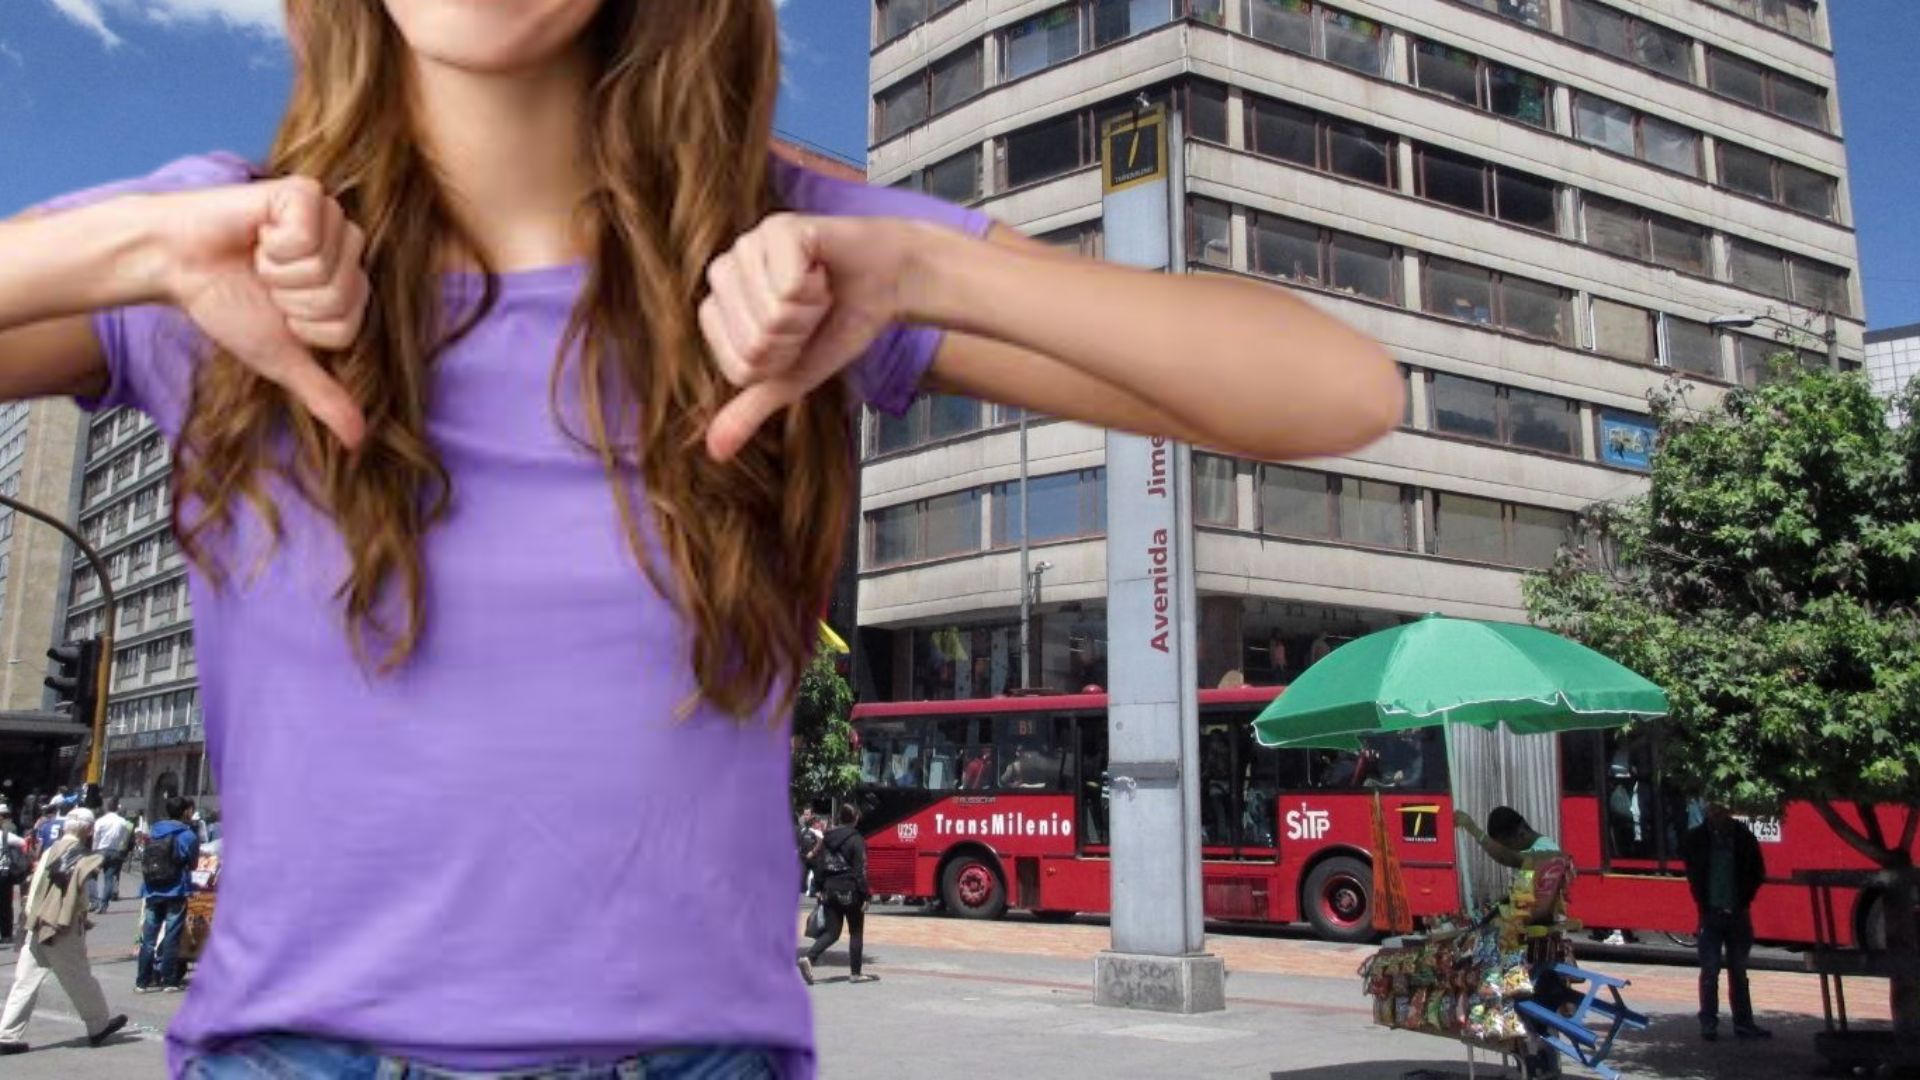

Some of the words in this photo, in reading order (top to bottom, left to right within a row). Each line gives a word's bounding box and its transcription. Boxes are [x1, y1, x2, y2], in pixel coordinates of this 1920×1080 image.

[1148, 528, 1169, 653] Avenida
[897, 823, 918, 837] U250
[935, 813, 1072, 836] TransMilenio
